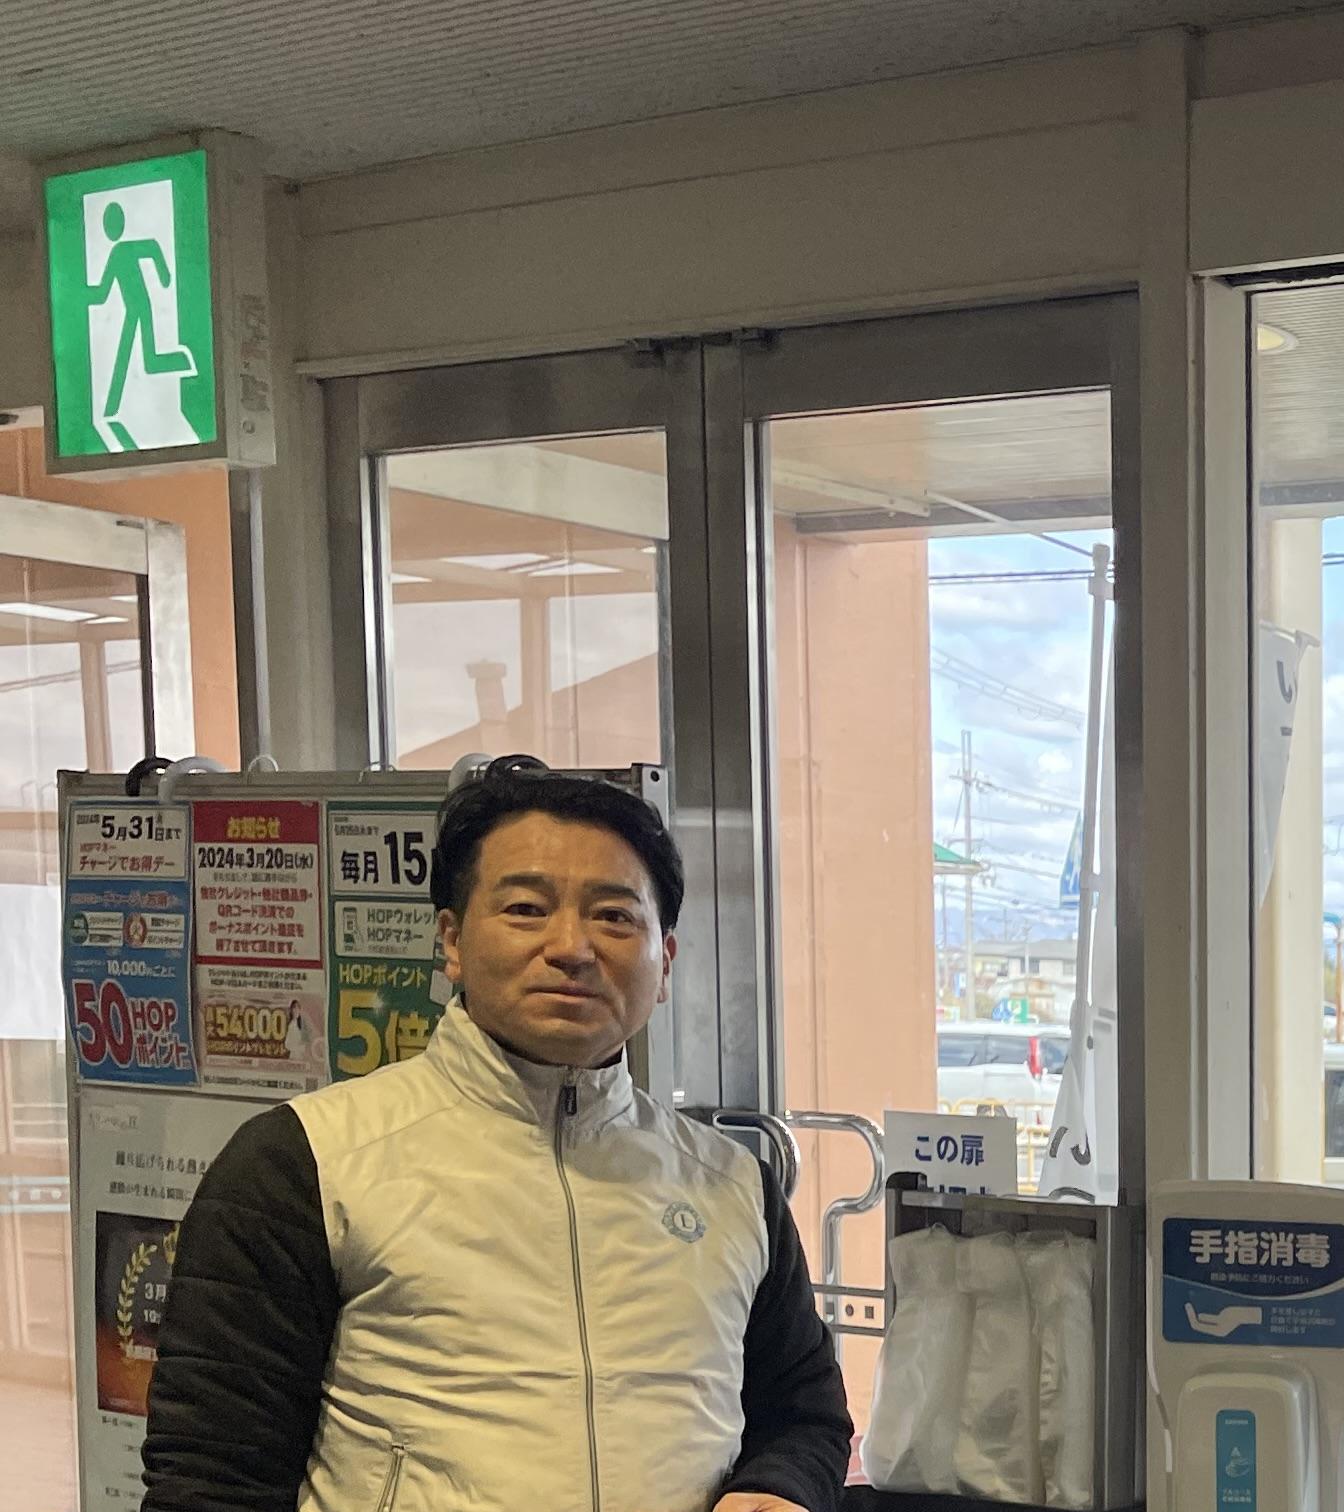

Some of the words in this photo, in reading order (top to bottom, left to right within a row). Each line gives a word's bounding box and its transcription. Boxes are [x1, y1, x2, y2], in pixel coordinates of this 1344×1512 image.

[226, 815, 280, 839] お知らせ
[79, 855, 175, 873] チャージでお得デー
[198, 847, 314, 869] 2024年3月20日(水)
[367, 927, 424, 943] HOPマネー
[339, 963, 427, 988] HOPポイント
[72, 978, 133, 1069] 50
[128, 998, 178, 1033] HOP
[136, 1030, 188, 1069] ポイント
[915, 1134, 985, 1167] この扉
[1188, 1229, 1331, 1268] 手指消毒
